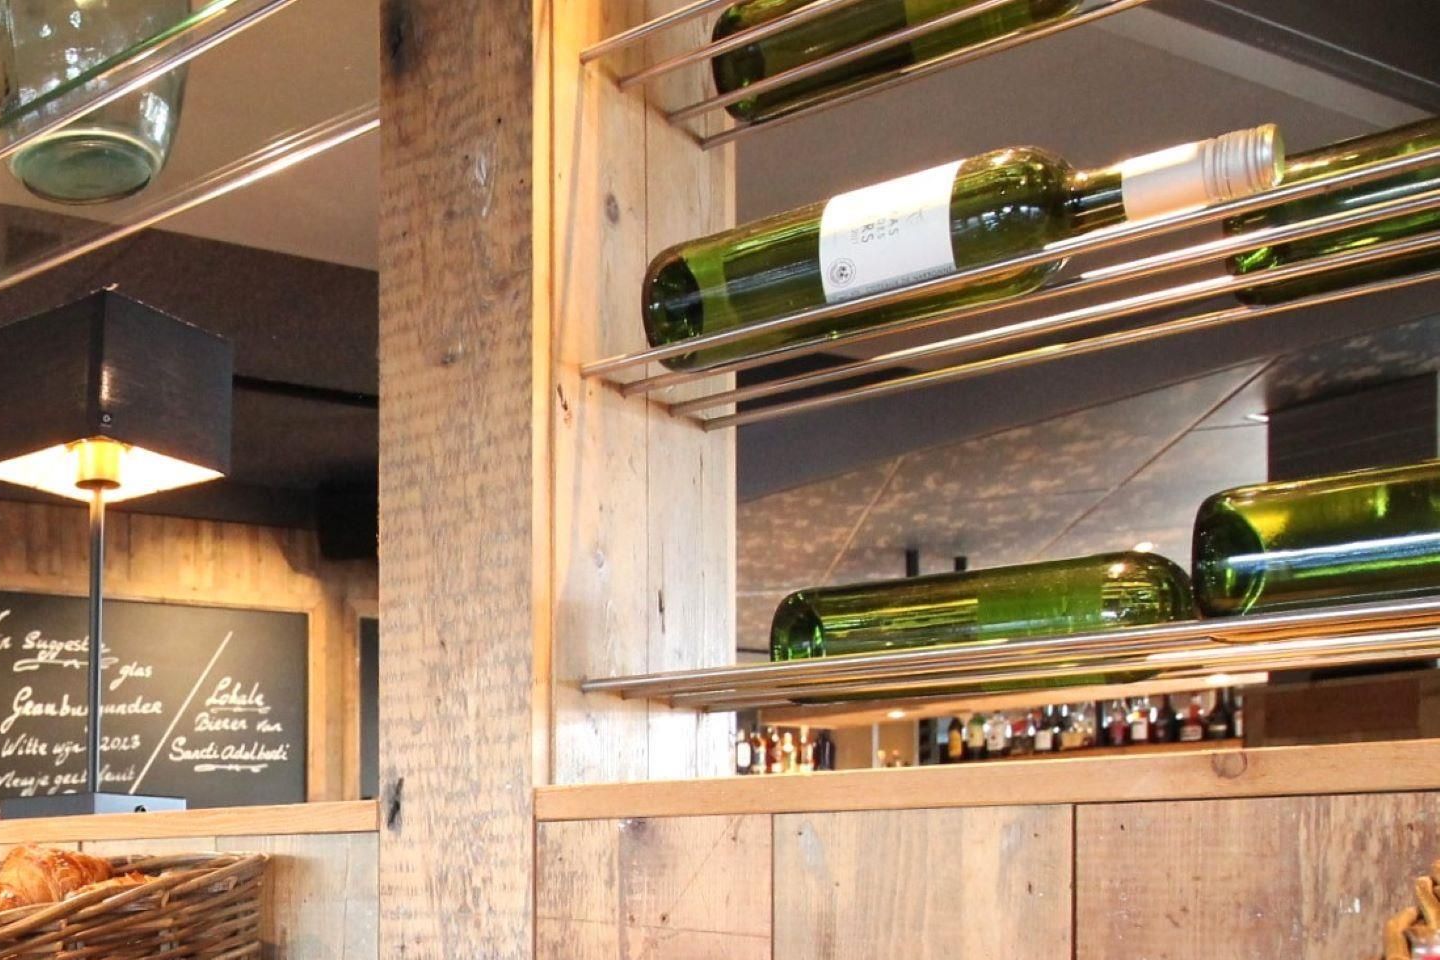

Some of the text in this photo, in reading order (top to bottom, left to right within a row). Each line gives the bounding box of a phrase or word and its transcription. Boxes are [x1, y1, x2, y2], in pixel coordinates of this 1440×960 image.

[109, 661, 153, 691] glas
[205, 676, 265, 706] Lokale
[194, 711, 284, 733] Bieren van
[0, 733, 141, 767] Witte wijn 2013
[169, 735, 220, 762] Sancti
